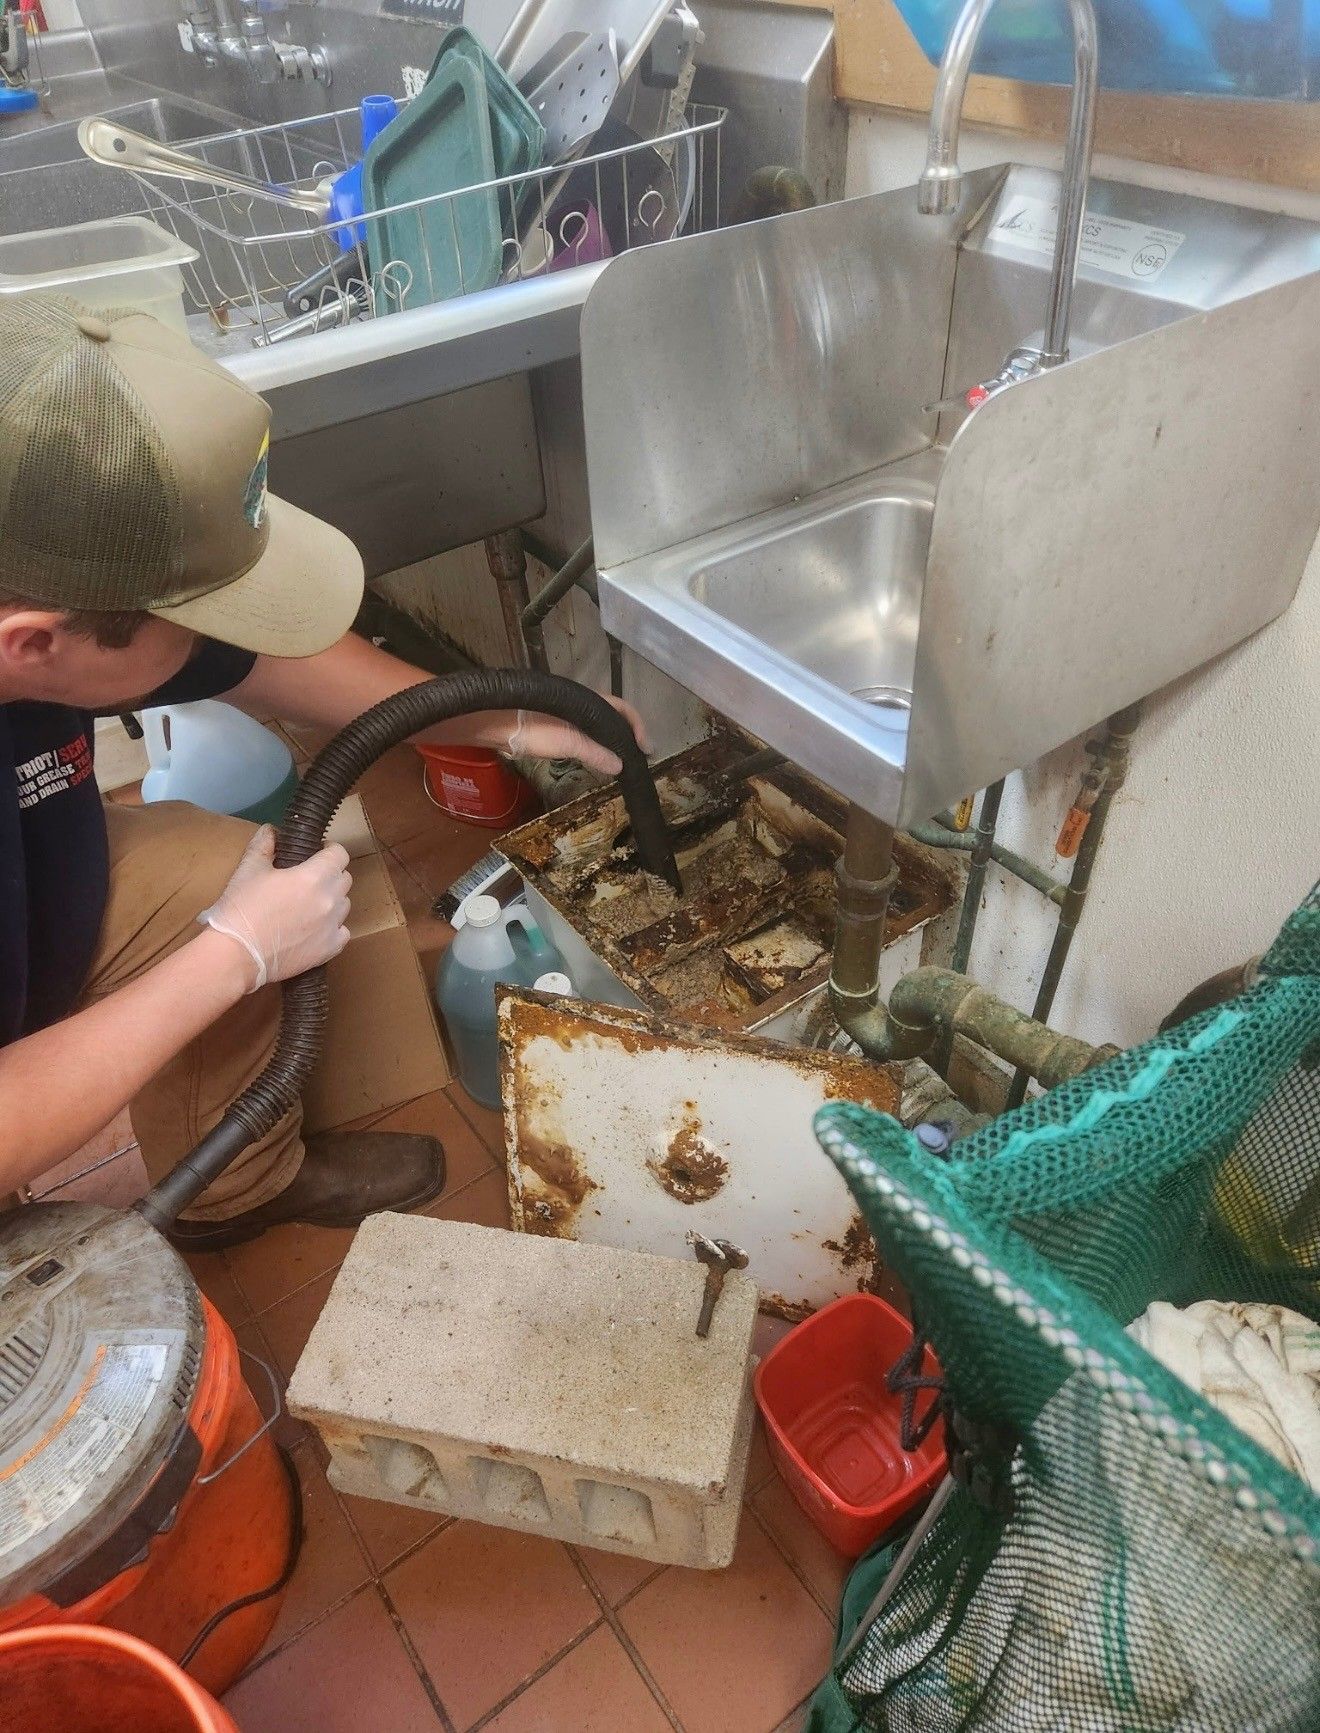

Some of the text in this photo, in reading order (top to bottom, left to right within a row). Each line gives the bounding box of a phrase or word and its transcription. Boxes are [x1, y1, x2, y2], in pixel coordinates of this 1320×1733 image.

[1134, 253, 1164, 269] NSF
[36, 763, 76, 787] GREASE
[19, 793, 40, 809] AND
[38, 778, 70, 800] DRAIN
